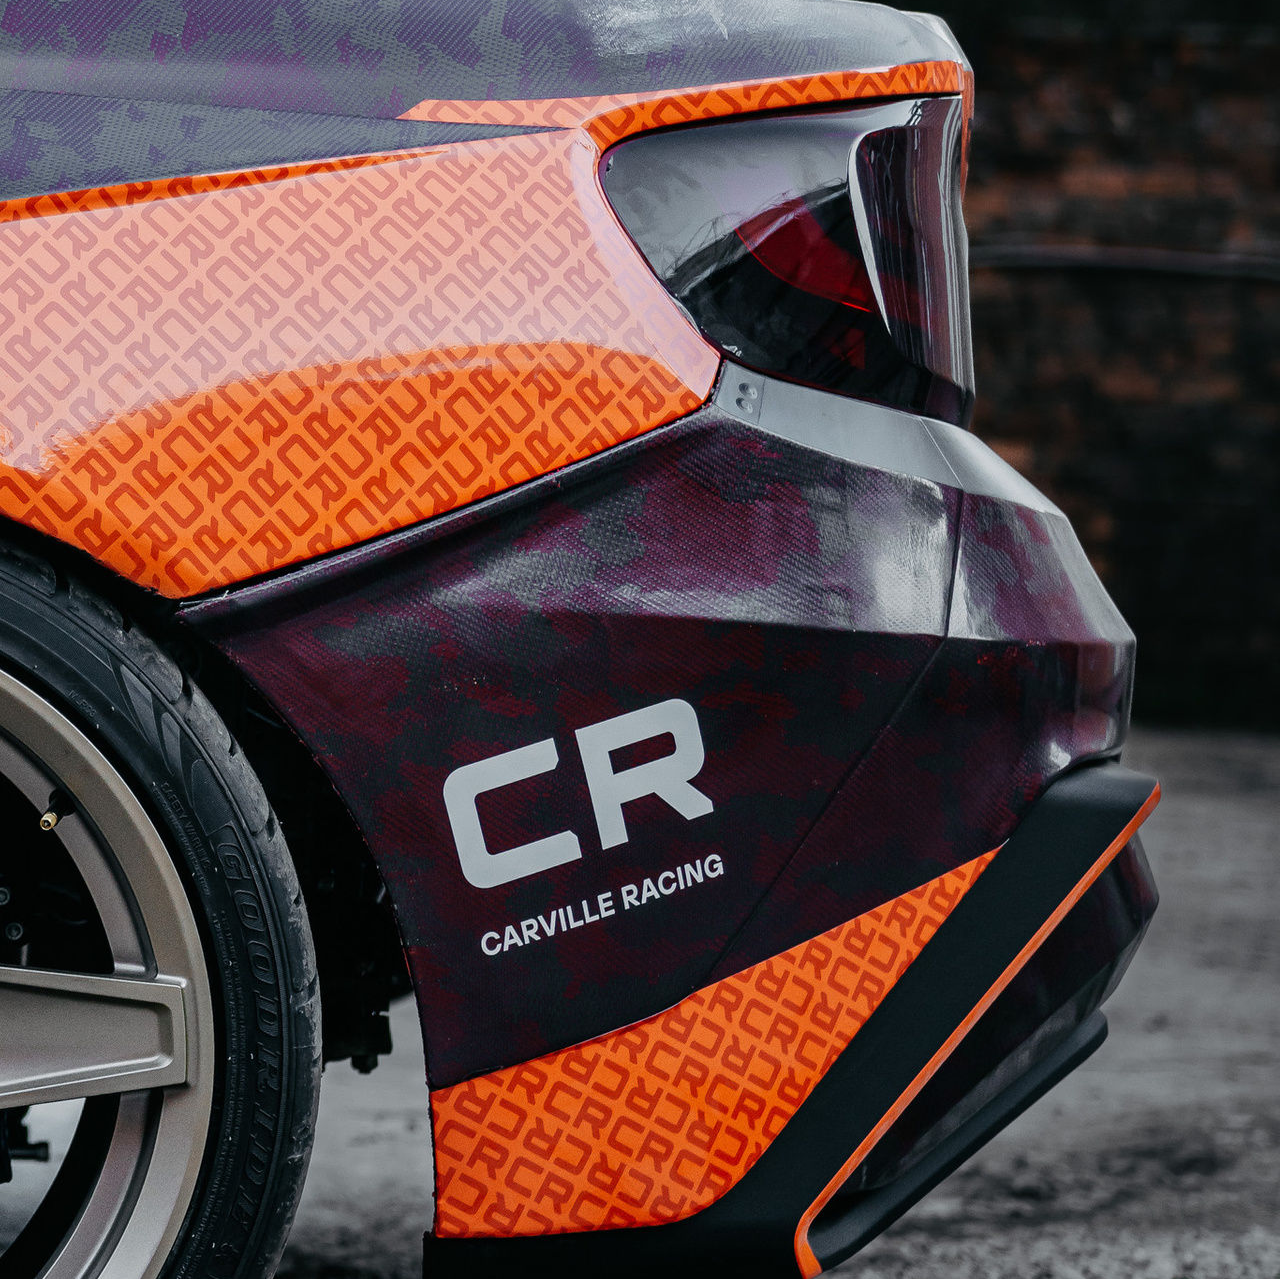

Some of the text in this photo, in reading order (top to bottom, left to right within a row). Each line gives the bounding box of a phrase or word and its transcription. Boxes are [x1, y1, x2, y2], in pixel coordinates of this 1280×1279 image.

[443, 699, 714, 889] CR
[481, 854, 724, 956] CARVILLE RACING
[216, 834, 284, 1237] GOODRIDE
